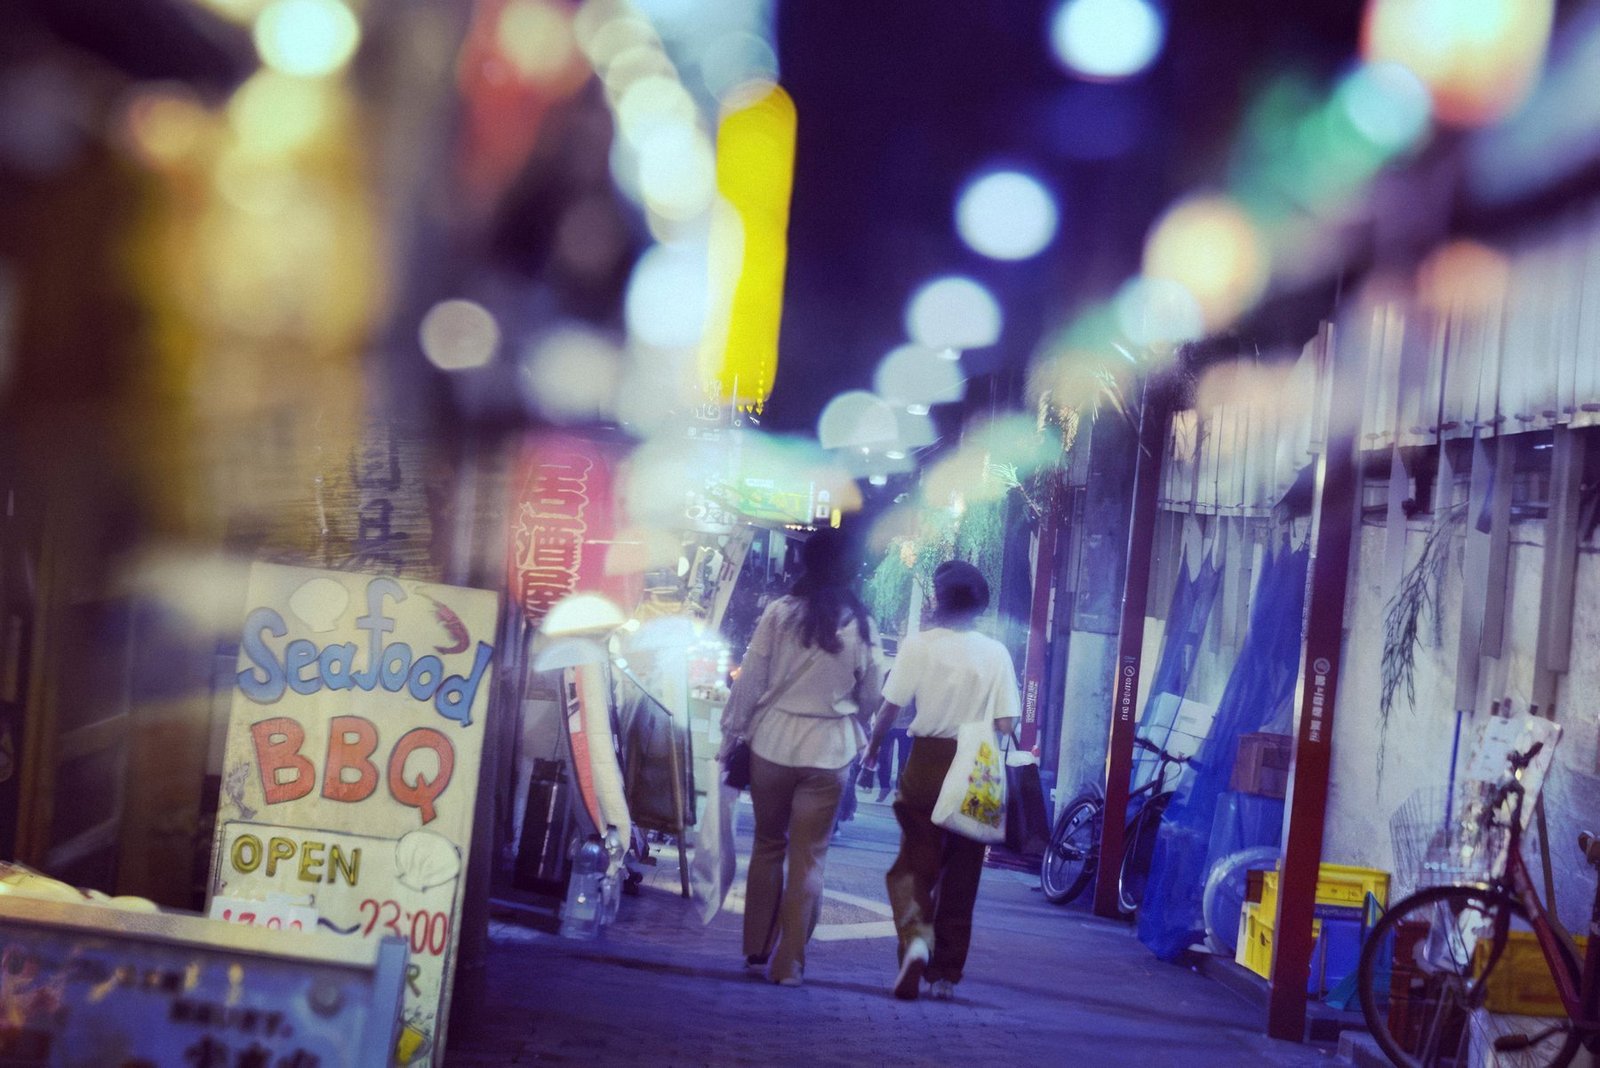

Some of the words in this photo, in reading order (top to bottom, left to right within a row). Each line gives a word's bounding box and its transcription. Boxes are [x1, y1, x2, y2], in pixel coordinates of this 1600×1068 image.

[236, 576, 494, 728] Seafood
[249, 714, 456, 826] BBQ
[230, 833, 363, 888] OPEN
